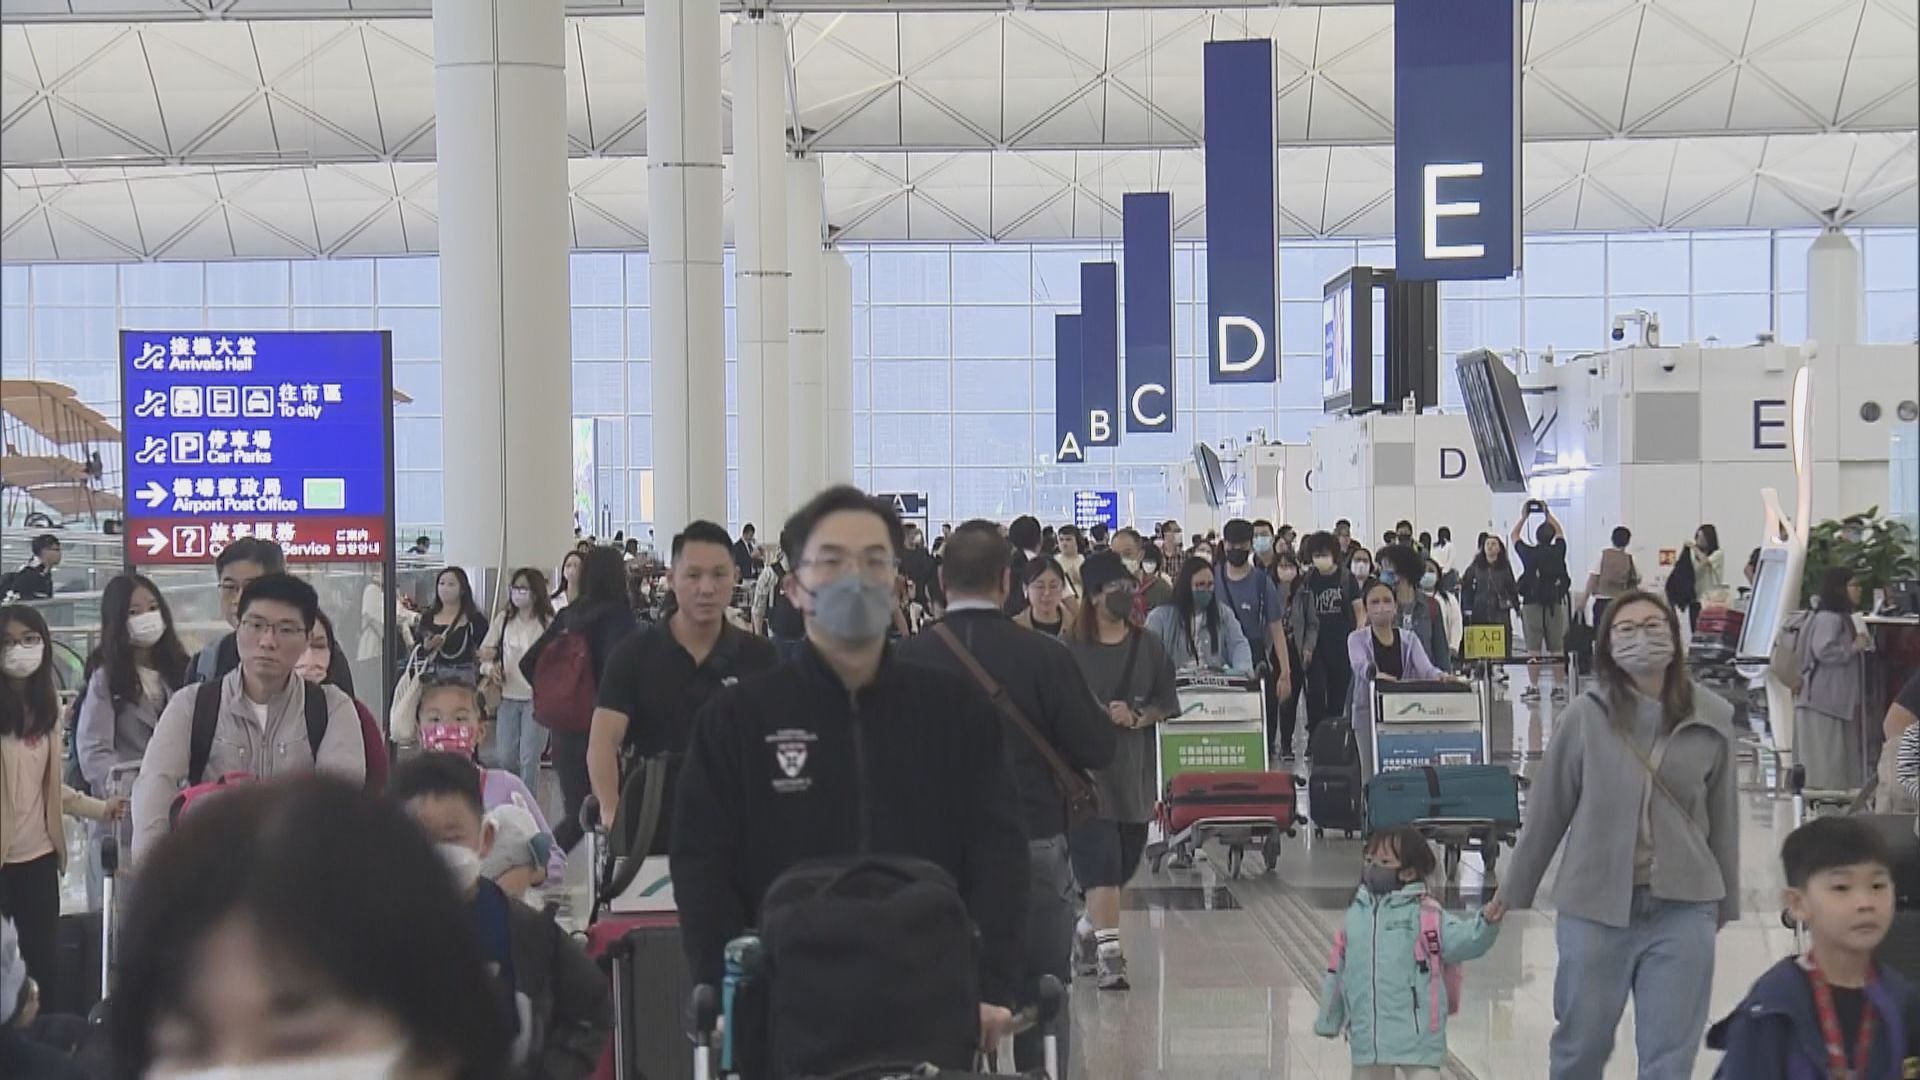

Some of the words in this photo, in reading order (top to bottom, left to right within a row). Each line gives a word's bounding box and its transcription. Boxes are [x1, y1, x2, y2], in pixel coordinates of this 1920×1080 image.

[1424, 162, 1485, 259] E
[169, 335, 257, 356] 接機大堂
[1218, 316, 1266, 373] D
[168, 355, 224, 371] Arrivals
[224, 355, 253, 371] Hall
[278, 382, 342, 403] 往市區
[277, 401, 296, 418] To
[296, 401, 322, 420] city
[1131, 383, 1168, 426] C
[1090, 410, 1112, 442] B
[1753, 399, 1788, 450] E
[208, 429, 272, 450] 停車場
[1057, 431, 1083, 460] A
[207, 449, 232, 463] Car
[233, 448, 272, 463] Parks
[1440, 447, 1467, 480] D
[172, 498, 223, 515] Airport
[223, 497, 256, 511] Post
[256, 497, 299, 511] Office
[893, 495, 907, 512] A
[282, 541, 331, 556] Service
[1480, 630, 1501, 642] 入口
